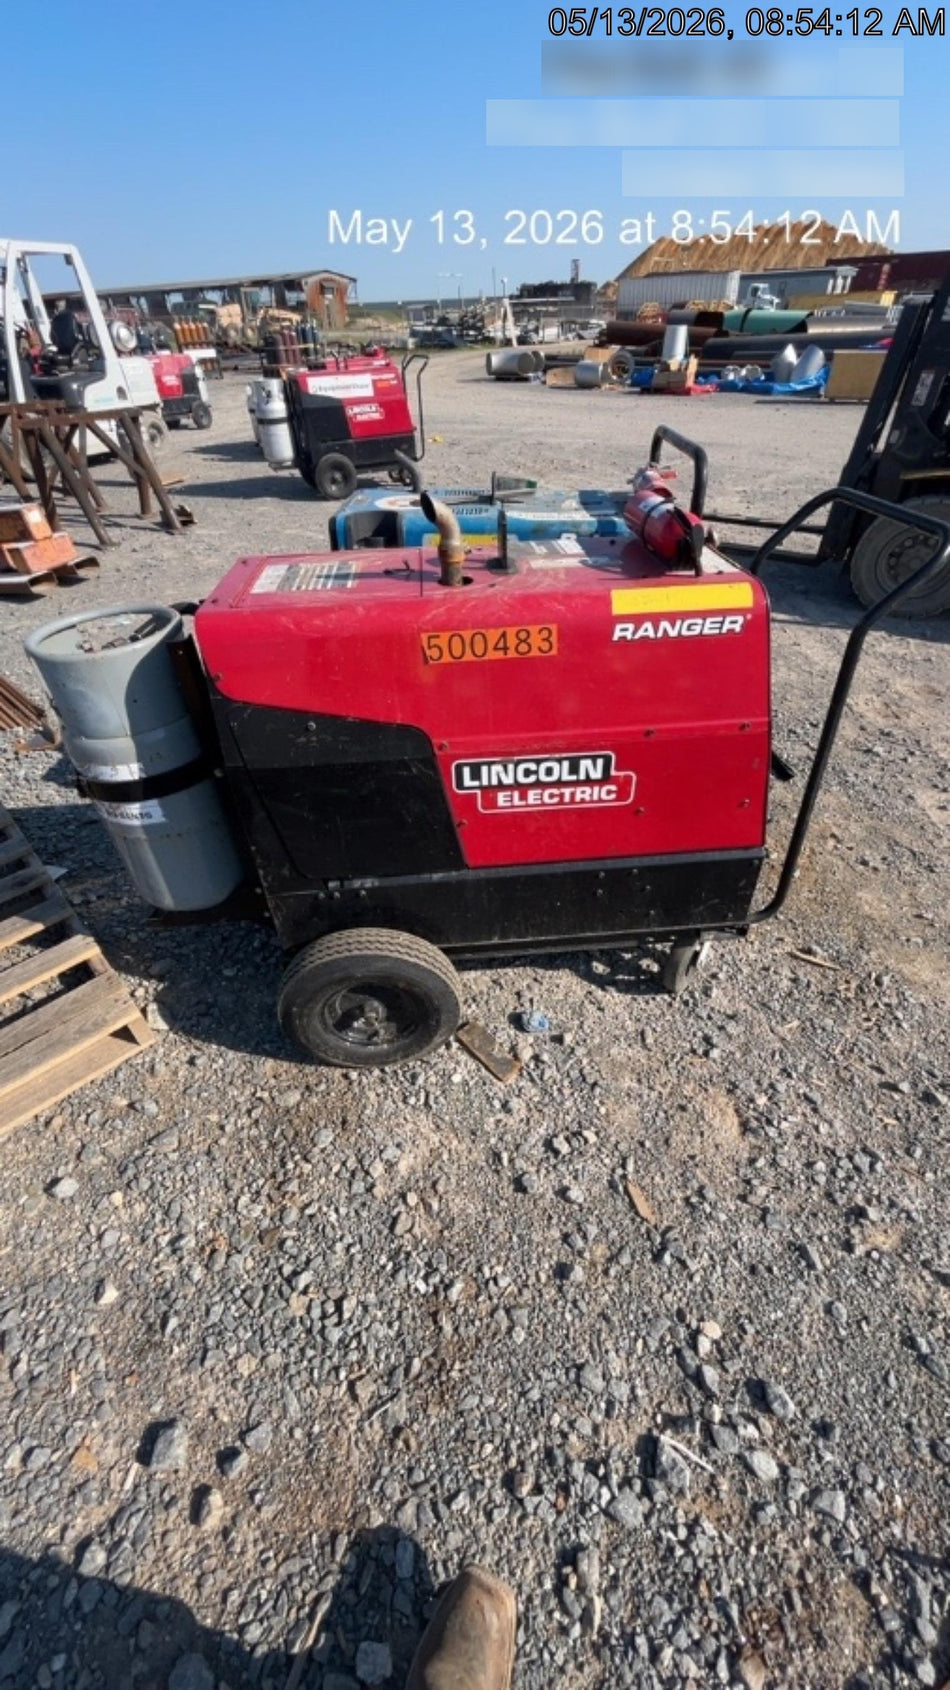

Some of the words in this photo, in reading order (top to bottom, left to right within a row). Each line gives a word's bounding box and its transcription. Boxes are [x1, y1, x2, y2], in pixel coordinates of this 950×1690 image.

[611, 615, 745, 641] RANGER
[426, 626, 553, 662] 500483
[462, 757, 605, 788] LINCOLN
[497, 784, 619, 808] ELECTRIC
